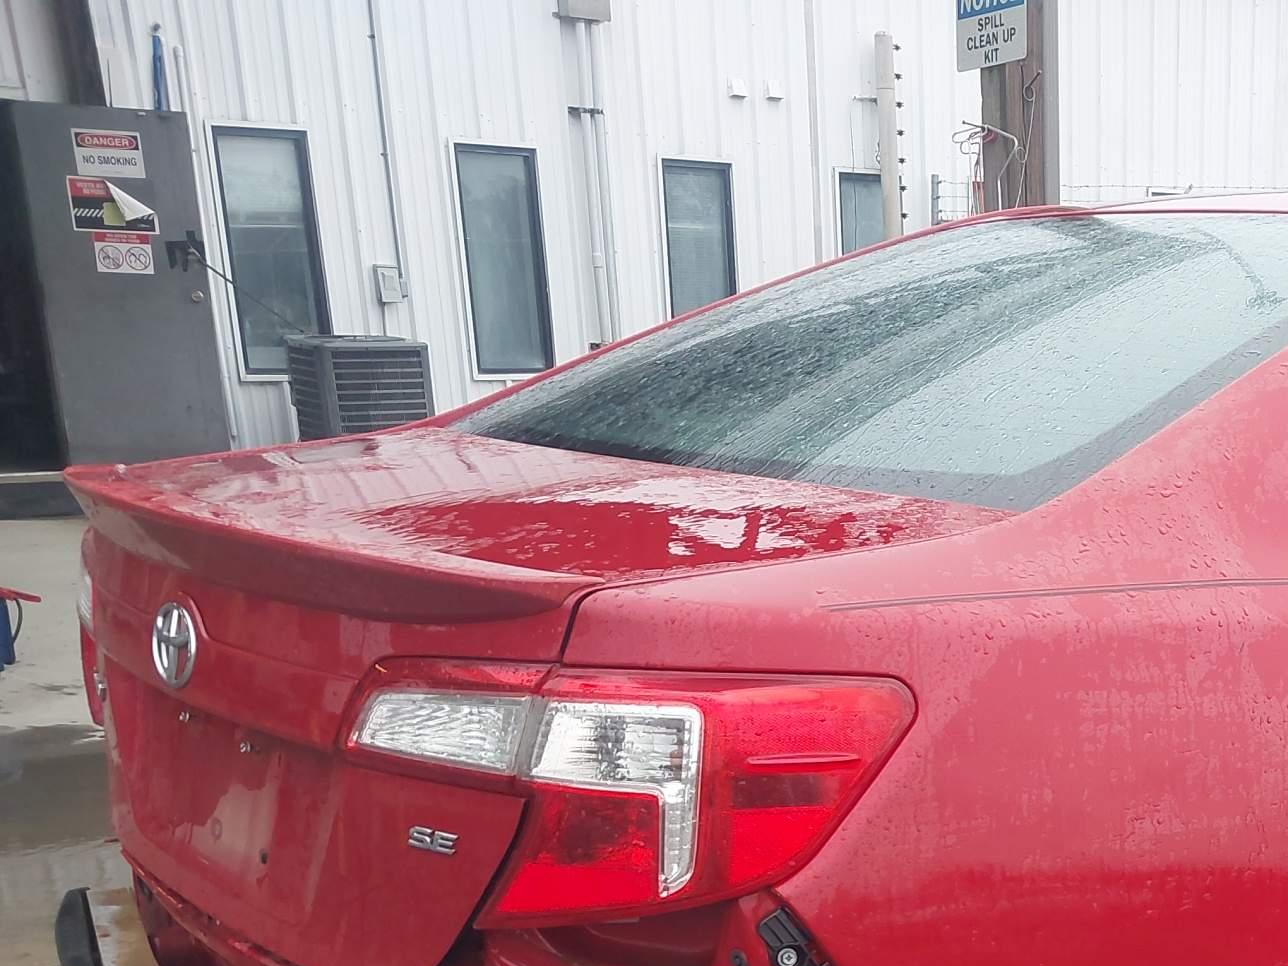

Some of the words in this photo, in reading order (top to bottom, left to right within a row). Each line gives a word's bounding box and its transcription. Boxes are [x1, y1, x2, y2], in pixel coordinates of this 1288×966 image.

[978, 14, 1004, 32] SPILL
[967, 32, 998, 50] CLEAN
[1003, 27, 1016, 42] UP
[984, 48, 999, 64] KIT
[85, 136, 129, 146] DANGER
[82, 154, 96, 165] NO
[97, 155, 137, 166] SMOKING
[408, 826, 458, 855] SE
